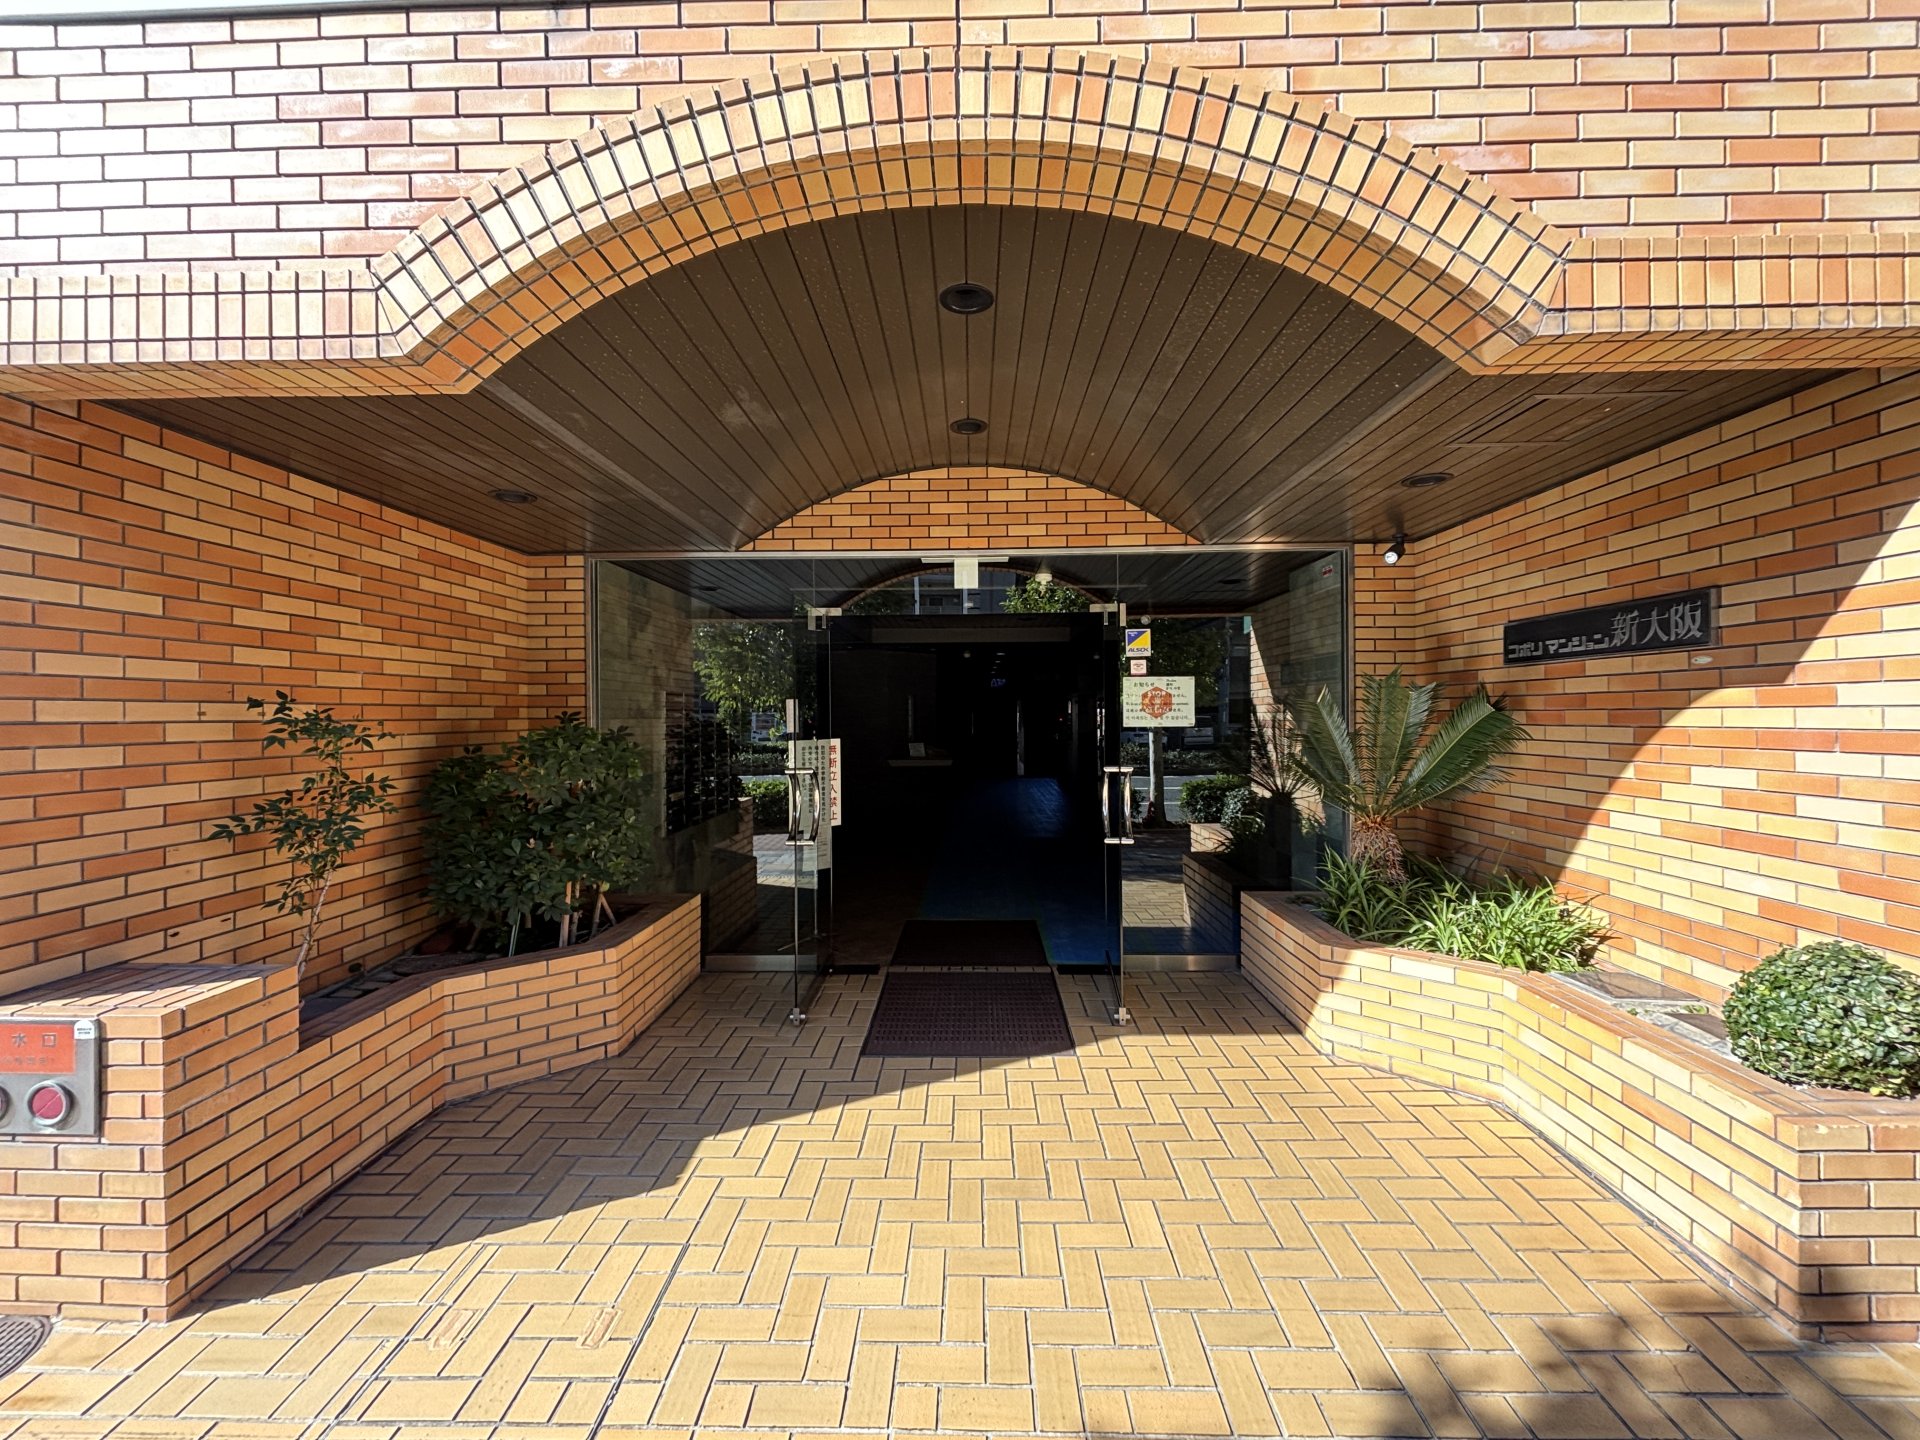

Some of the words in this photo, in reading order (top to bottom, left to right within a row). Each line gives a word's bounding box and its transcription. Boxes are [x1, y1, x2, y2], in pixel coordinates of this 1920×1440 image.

[829, 745, 837, 820] 無断立入禁止
